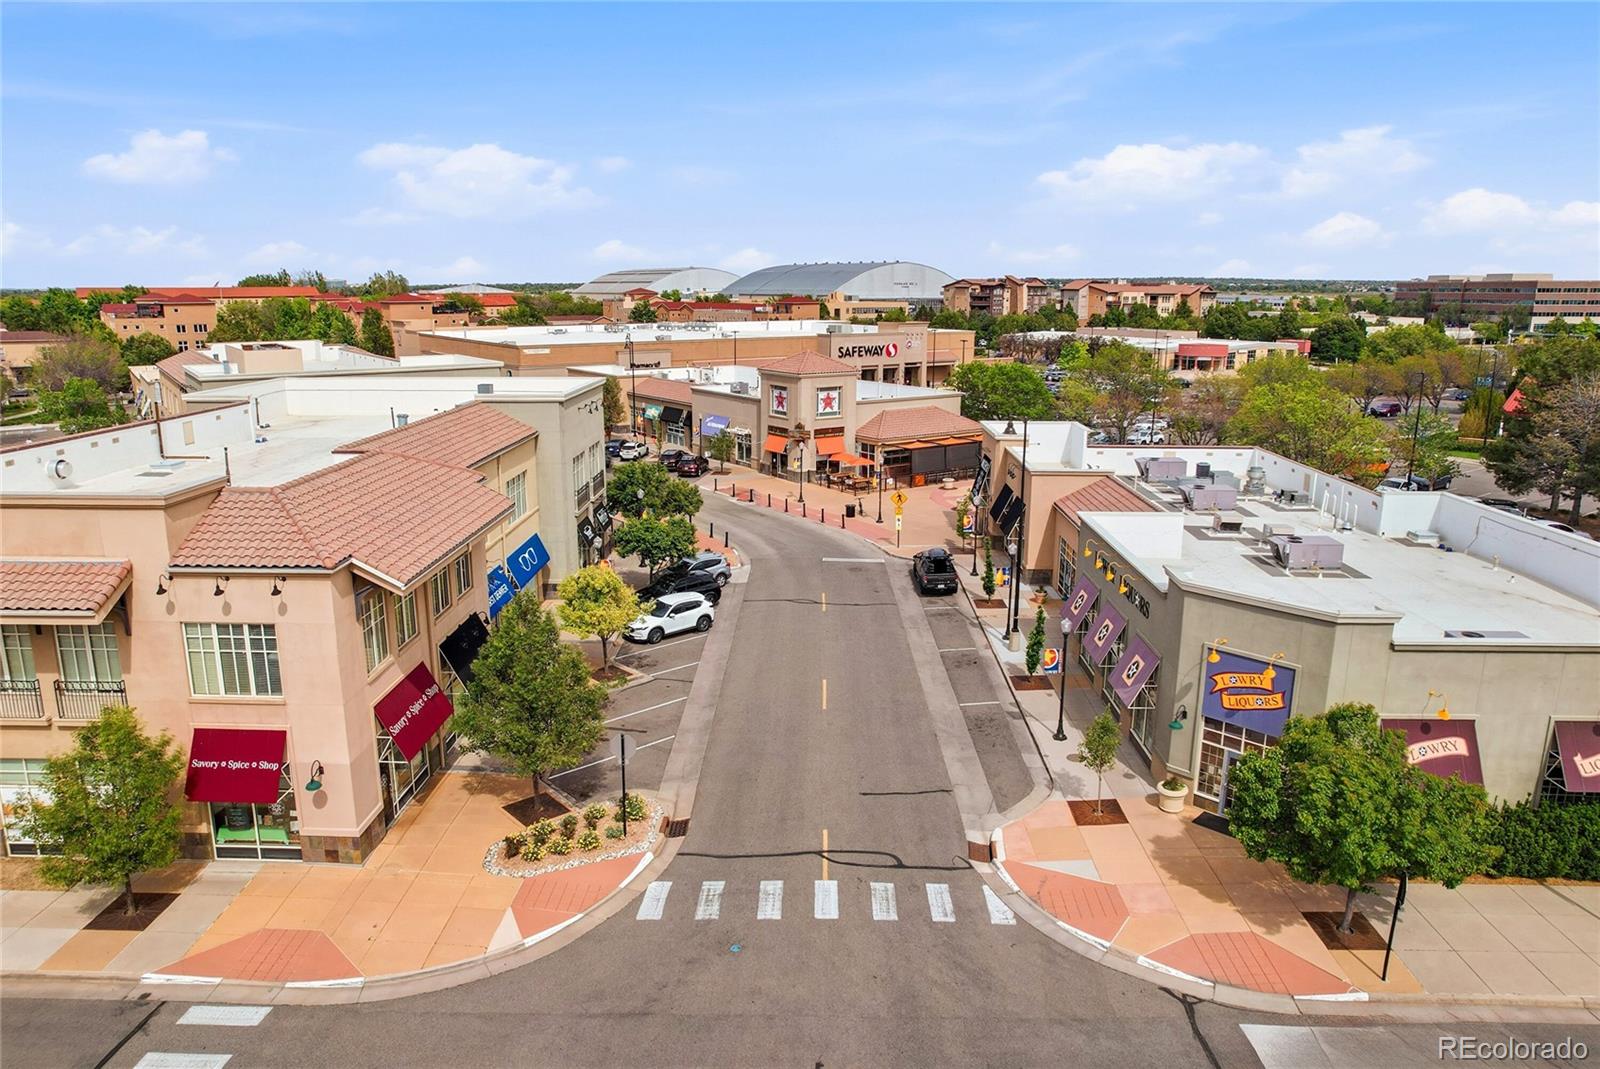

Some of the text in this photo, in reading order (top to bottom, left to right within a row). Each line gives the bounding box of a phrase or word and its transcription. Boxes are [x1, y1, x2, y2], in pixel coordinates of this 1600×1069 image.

[838, 345, 885, 359] SAFEWAY
[1220, 675, 1266, 686] LOWRY
[1228, 696, 1279, 707] LIQUORS
[389, 683, 440, 736] Savory Spice Shop
[1409, 739, 1459, 761] LOWRY
[191, 759, 279, 771] Savory Spice Shop
